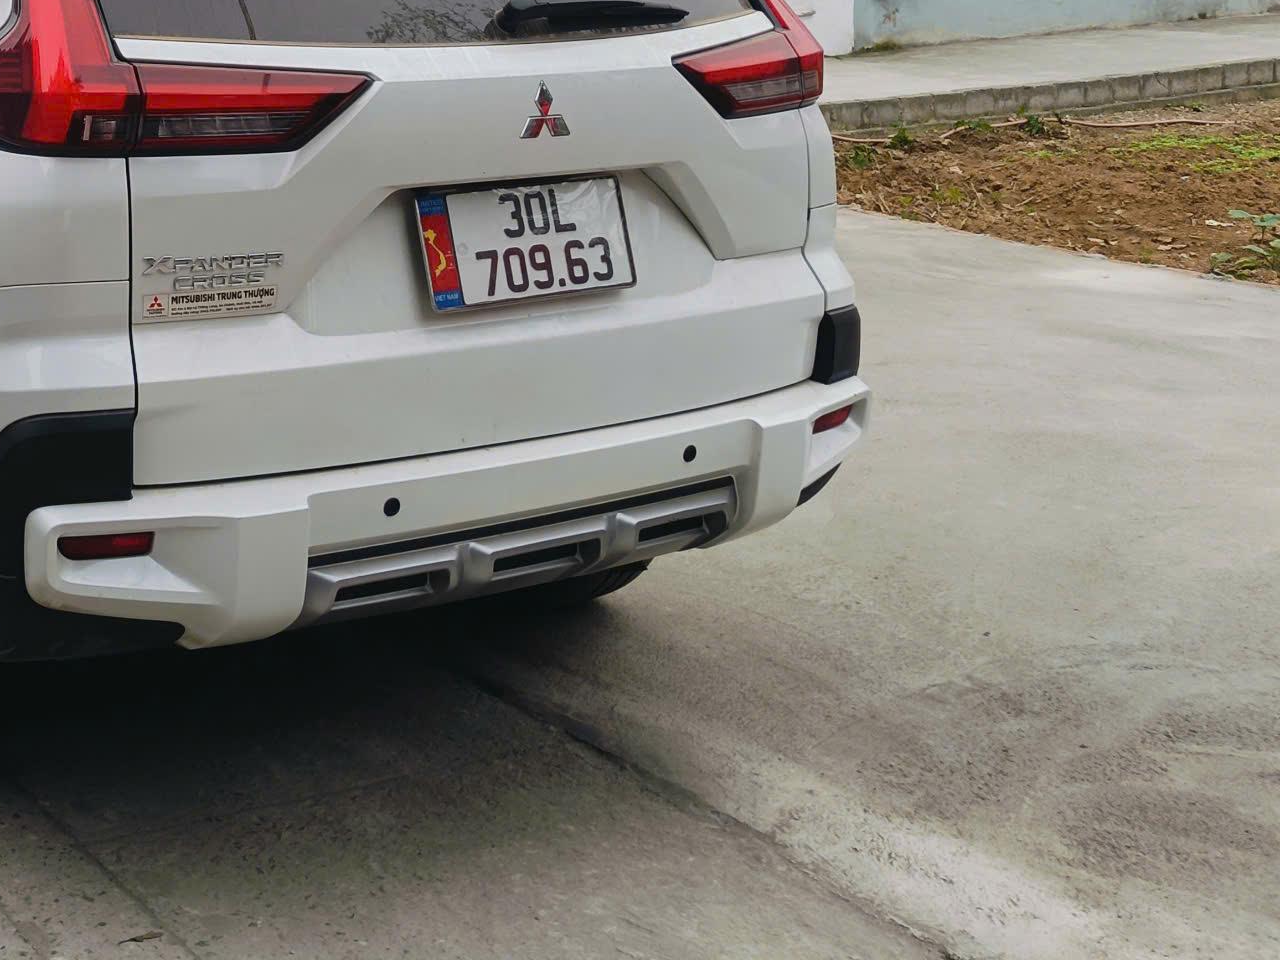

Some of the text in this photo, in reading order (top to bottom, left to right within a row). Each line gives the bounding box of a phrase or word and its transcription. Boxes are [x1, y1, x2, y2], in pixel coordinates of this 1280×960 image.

[498, 189, 577, 239] 30L
[143, 251, 284, 275] XPANDER
[475, 237, 614, 297] 709.63
[173, 271, 265, 290] CROSS
[171, 288, 275, 305] MITSUBISHI TRUNG THƯỢNG
